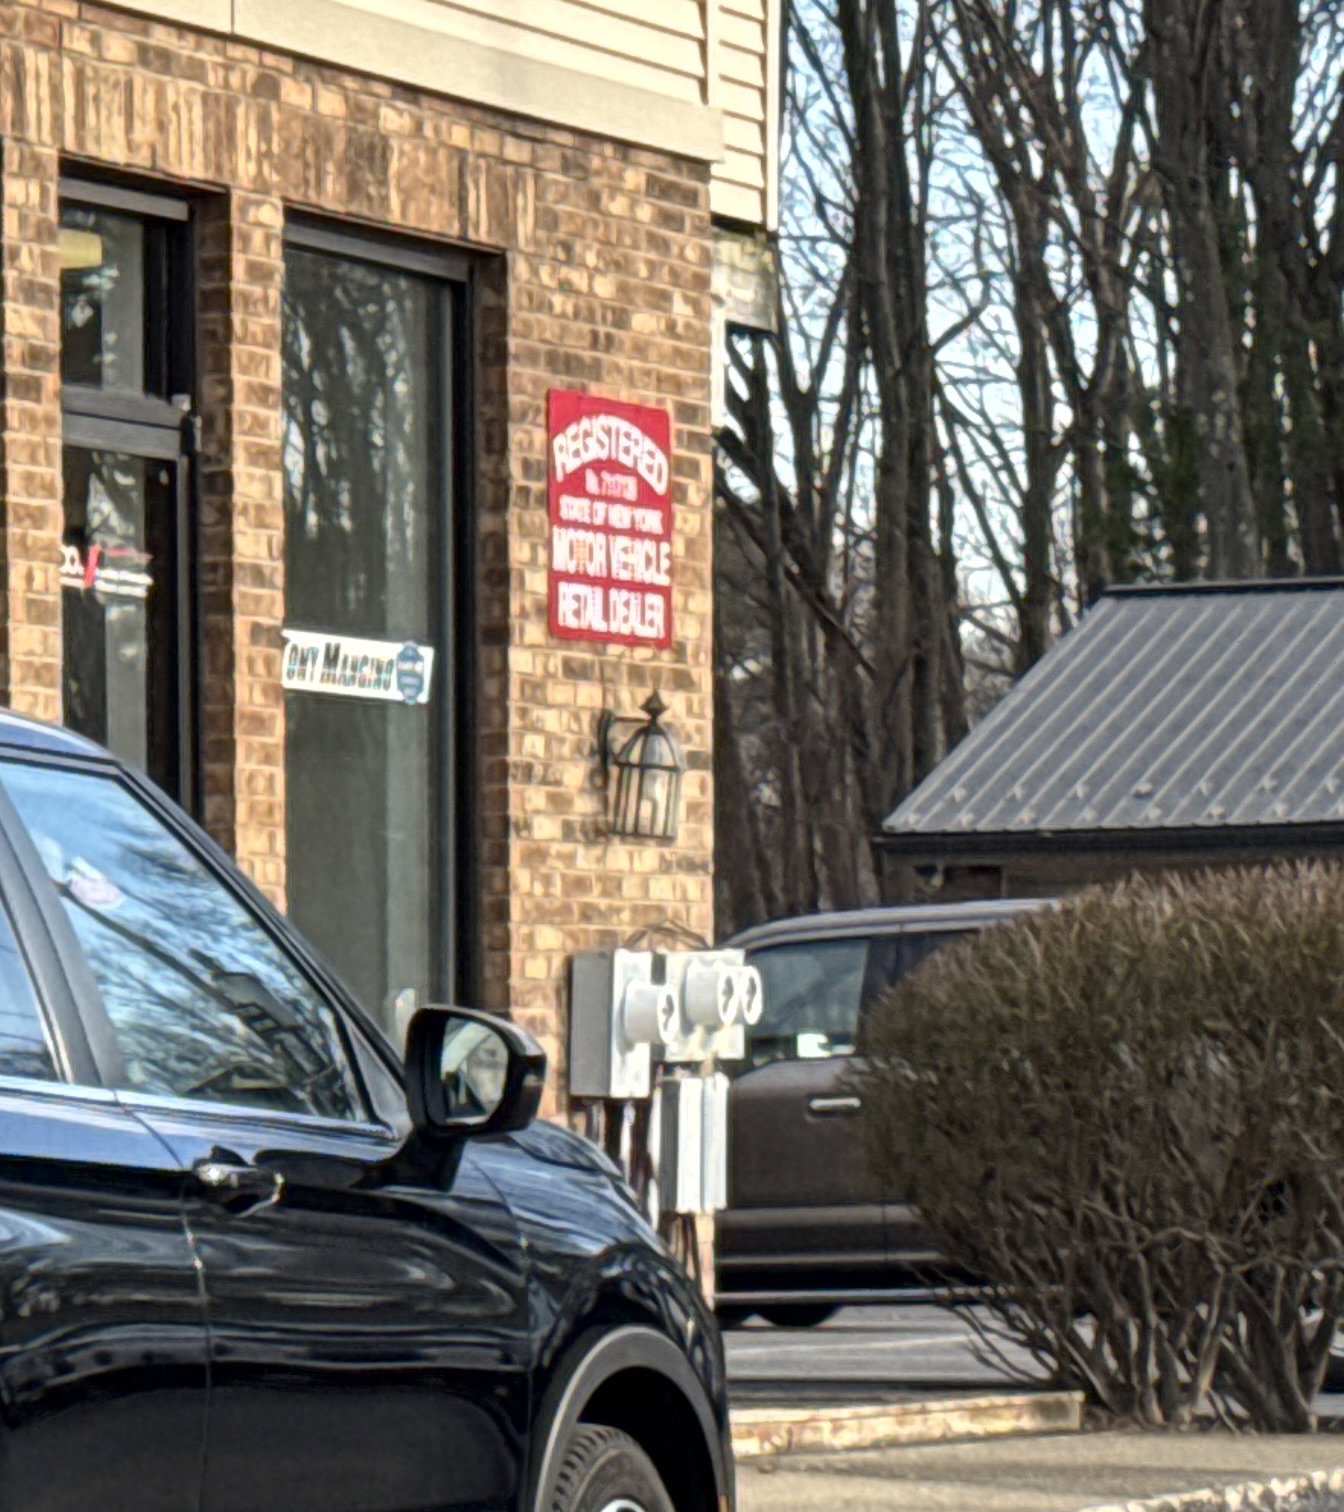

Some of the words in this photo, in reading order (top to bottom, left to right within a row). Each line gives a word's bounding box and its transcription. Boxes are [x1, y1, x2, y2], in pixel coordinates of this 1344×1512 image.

[552, 413, 670, 496] REGISTERED
[552, 525, 607, 578] MOTOR
[608, 534, 672, 586] VEHICLE
[557, 581, 607, 633] RETAIL
[608, 587, 666, 640] DEALER
[286, 643, 320, 682] ONY
